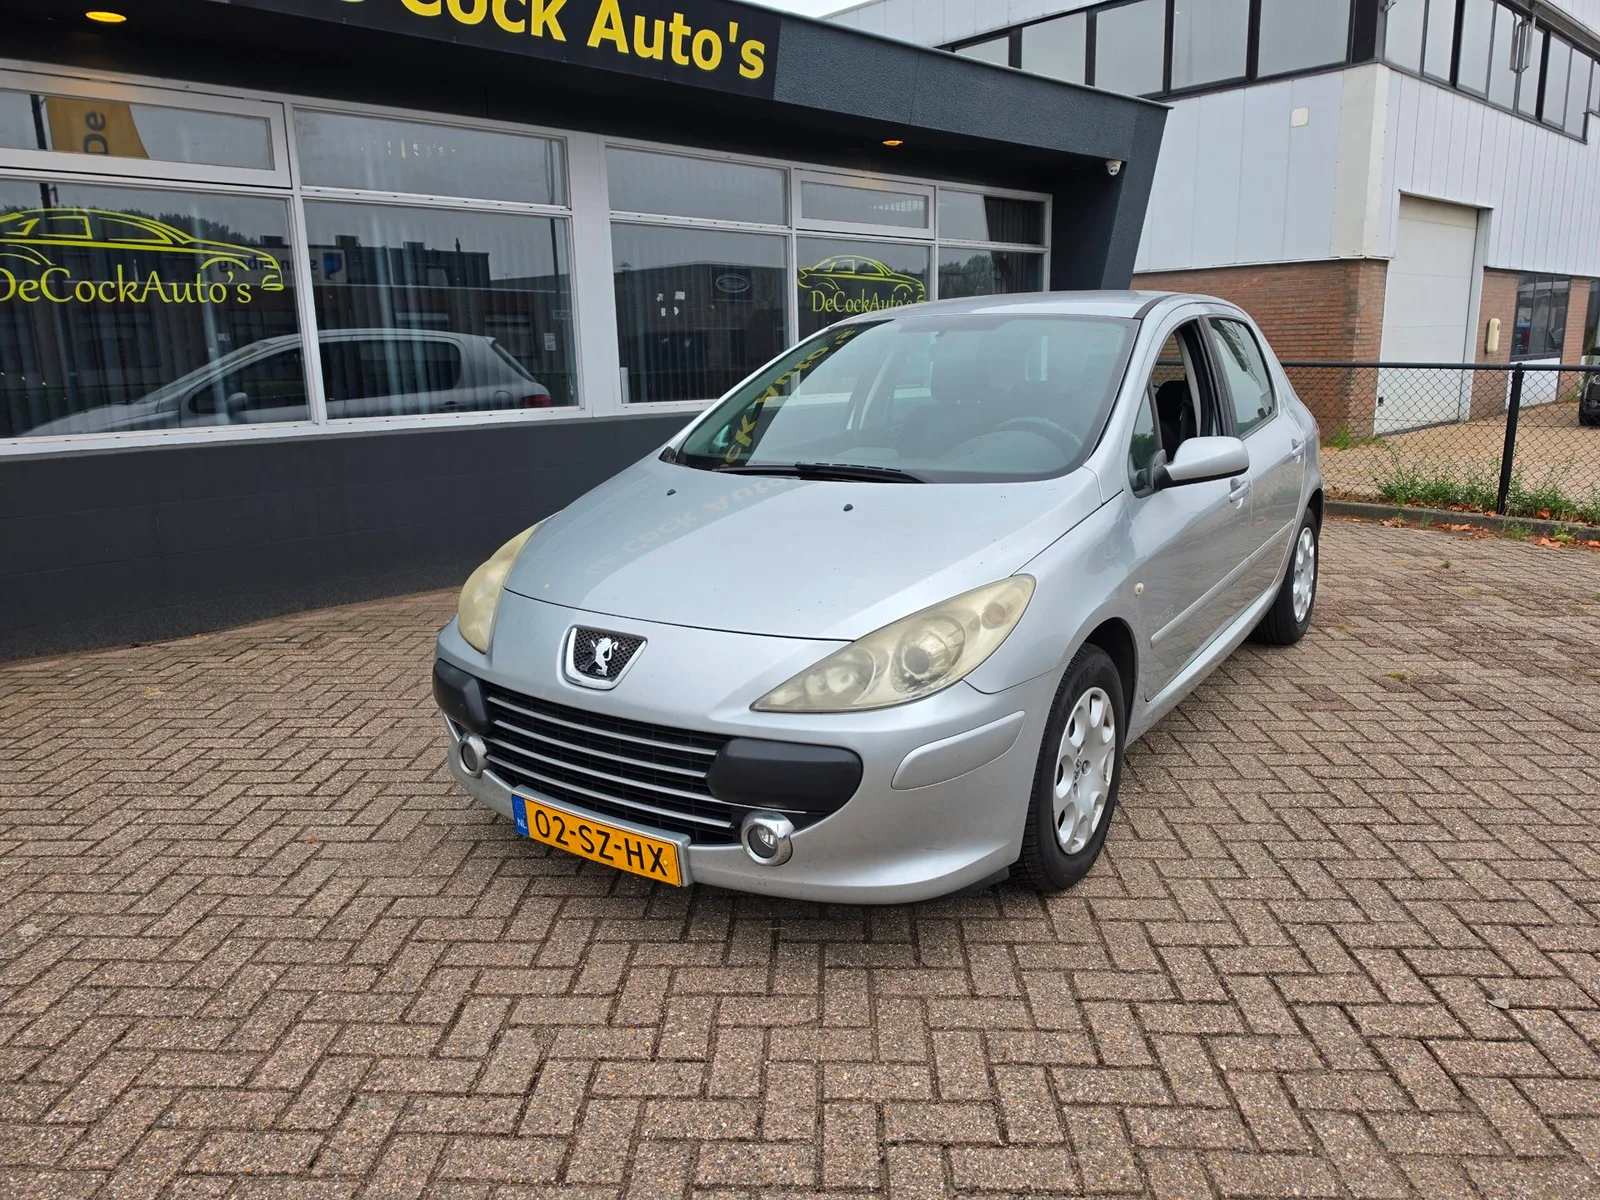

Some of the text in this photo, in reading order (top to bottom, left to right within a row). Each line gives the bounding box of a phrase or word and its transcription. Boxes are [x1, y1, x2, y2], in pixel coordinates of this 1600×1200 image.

[400, 0, 766, 80] ock Auto's
[83, 110, 109, 155] De
[517, 818, 528, 830] NL
[534, 809, 668, 877] 02-SZ-HX
